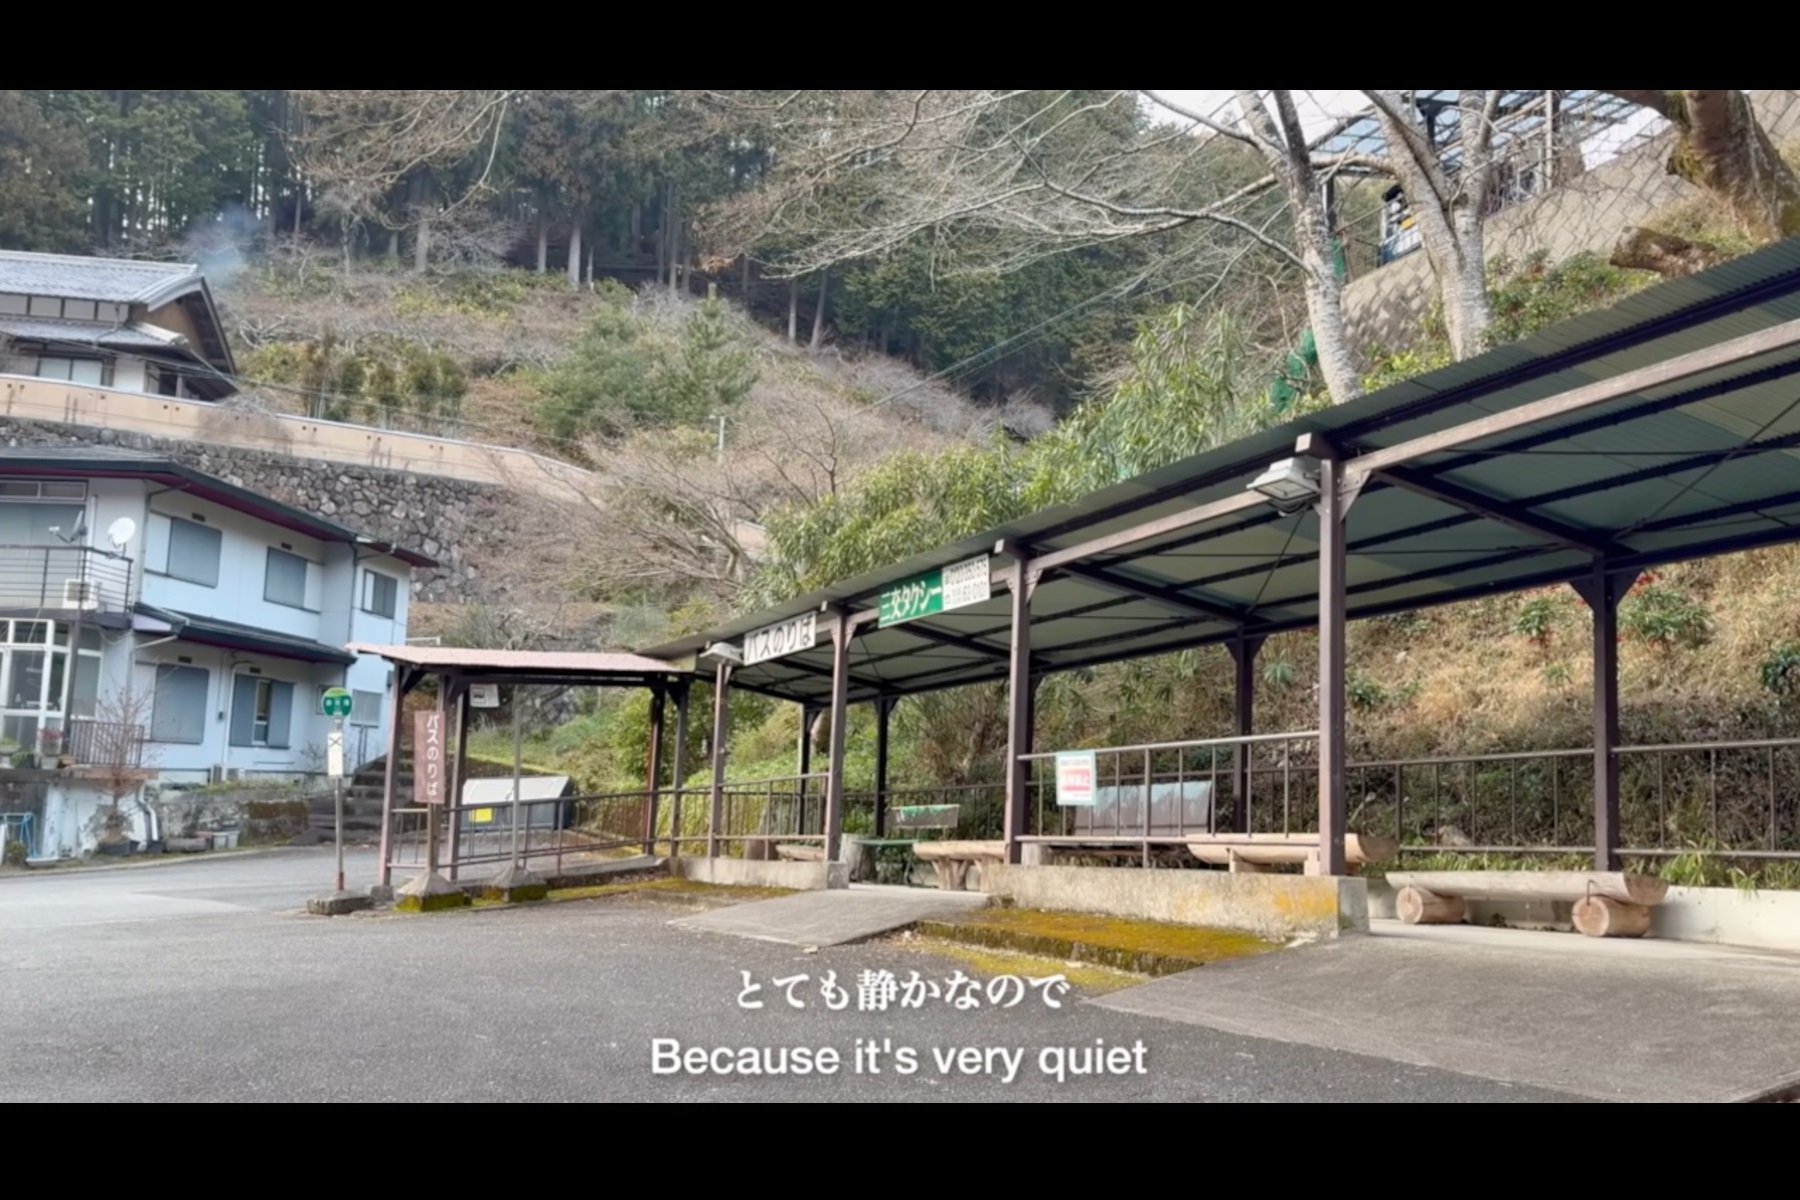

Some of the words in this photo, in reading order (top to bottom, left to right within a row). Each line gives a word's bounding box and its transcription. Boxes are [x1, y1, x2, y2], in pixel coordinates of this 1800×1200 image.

[880, 580, 942, 622] 三交タクシー
[746, 613, 813, 662] バスのりば
[426, 714, 440, 796] バスのりば
